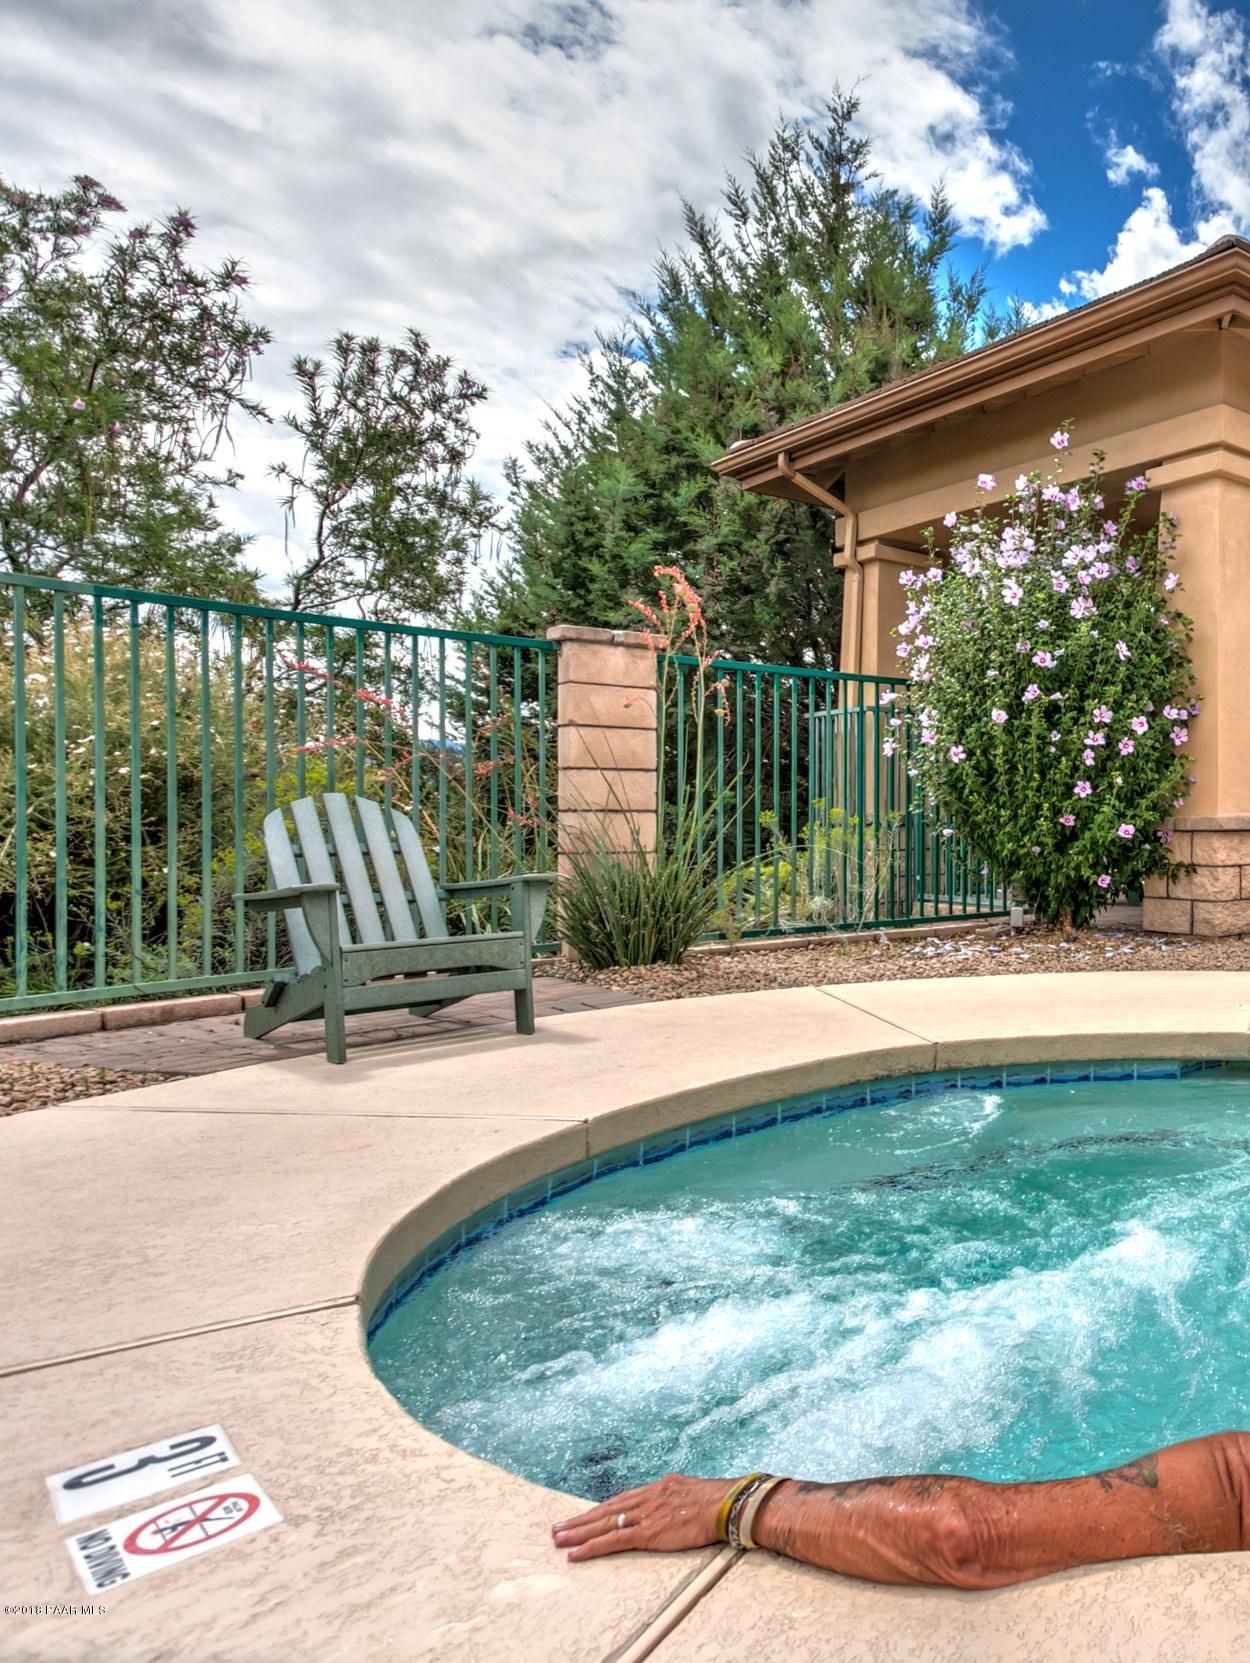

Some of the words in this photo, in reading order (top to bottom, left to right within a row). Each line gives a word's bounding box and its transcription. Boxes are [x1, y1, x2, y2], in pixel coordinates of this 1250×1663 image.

[62, 1435, 217, 1490] 3
[168, 1451, 229, 1478] FT
[76, 1528, 113, 1551] NO
[83, 1544, 131, 1588] DIVING
